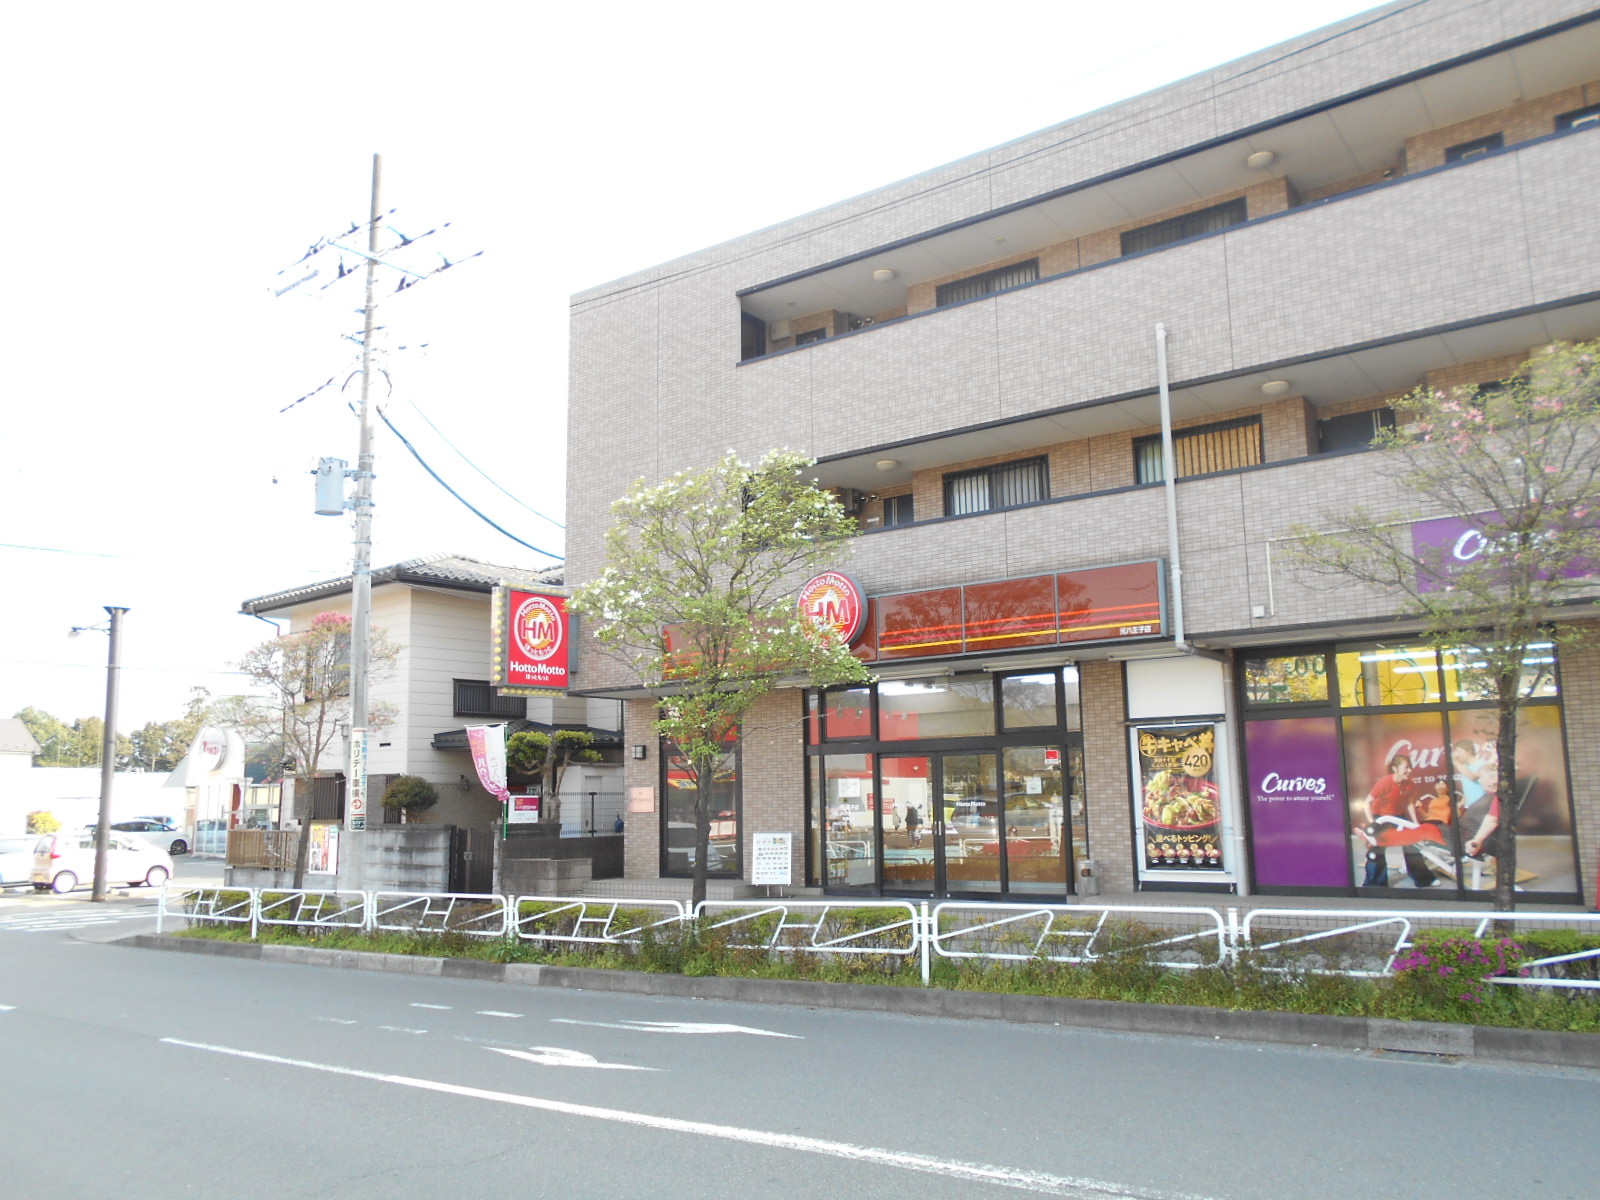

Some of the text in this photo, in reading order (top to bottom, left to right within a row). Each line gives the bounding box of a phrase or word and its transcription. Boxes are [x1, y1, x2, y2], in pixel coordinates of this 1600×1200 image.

[521, 618, 555, 642] HM
[1184, 754, 1208, 768] 420
[1261, 772, 1326, 794] Curves
